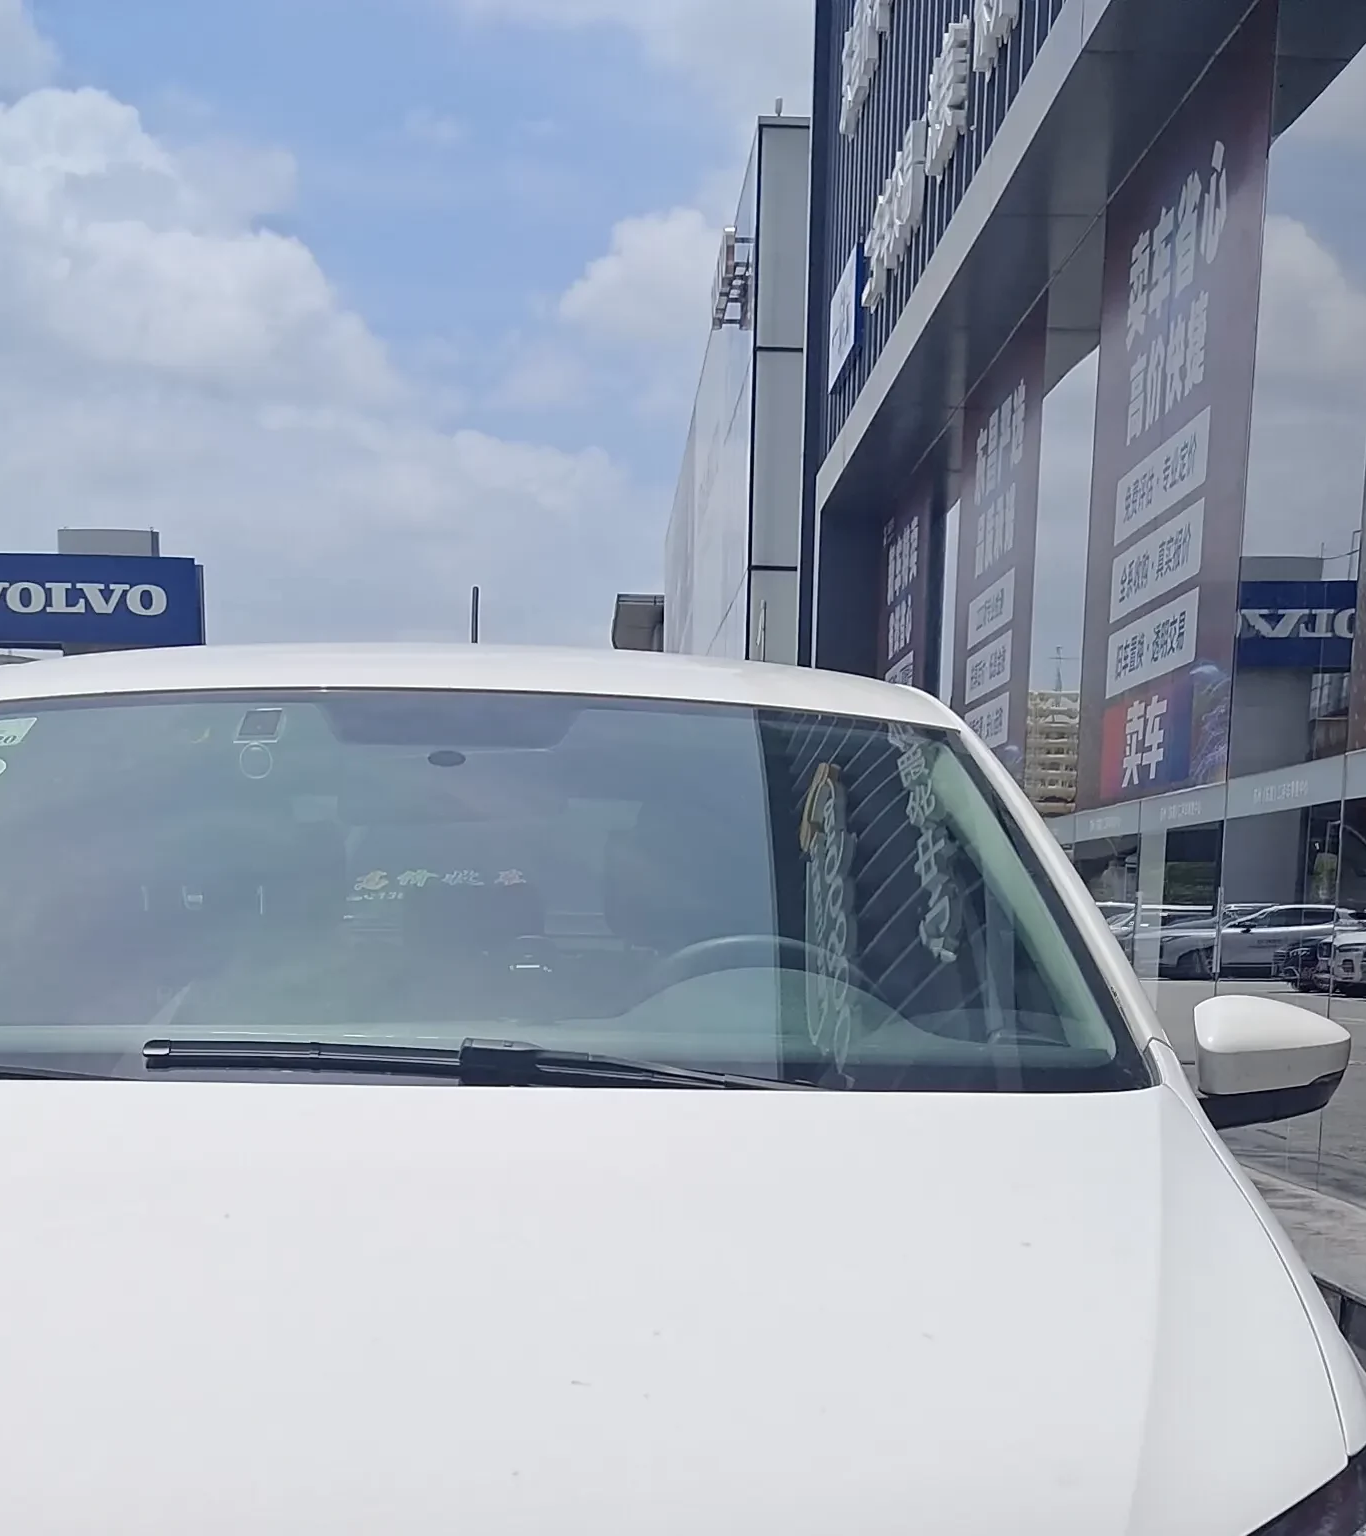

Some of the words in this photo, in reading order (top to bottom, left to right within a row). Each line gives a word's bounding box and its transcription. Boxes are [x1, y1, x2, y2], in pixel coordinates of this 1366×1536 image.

[1126, 139, 1227, 351] 卖车省心
[1126, 290, 1209, 447] 高价快捷
[1122, 694, 1168, 788] 卖车
